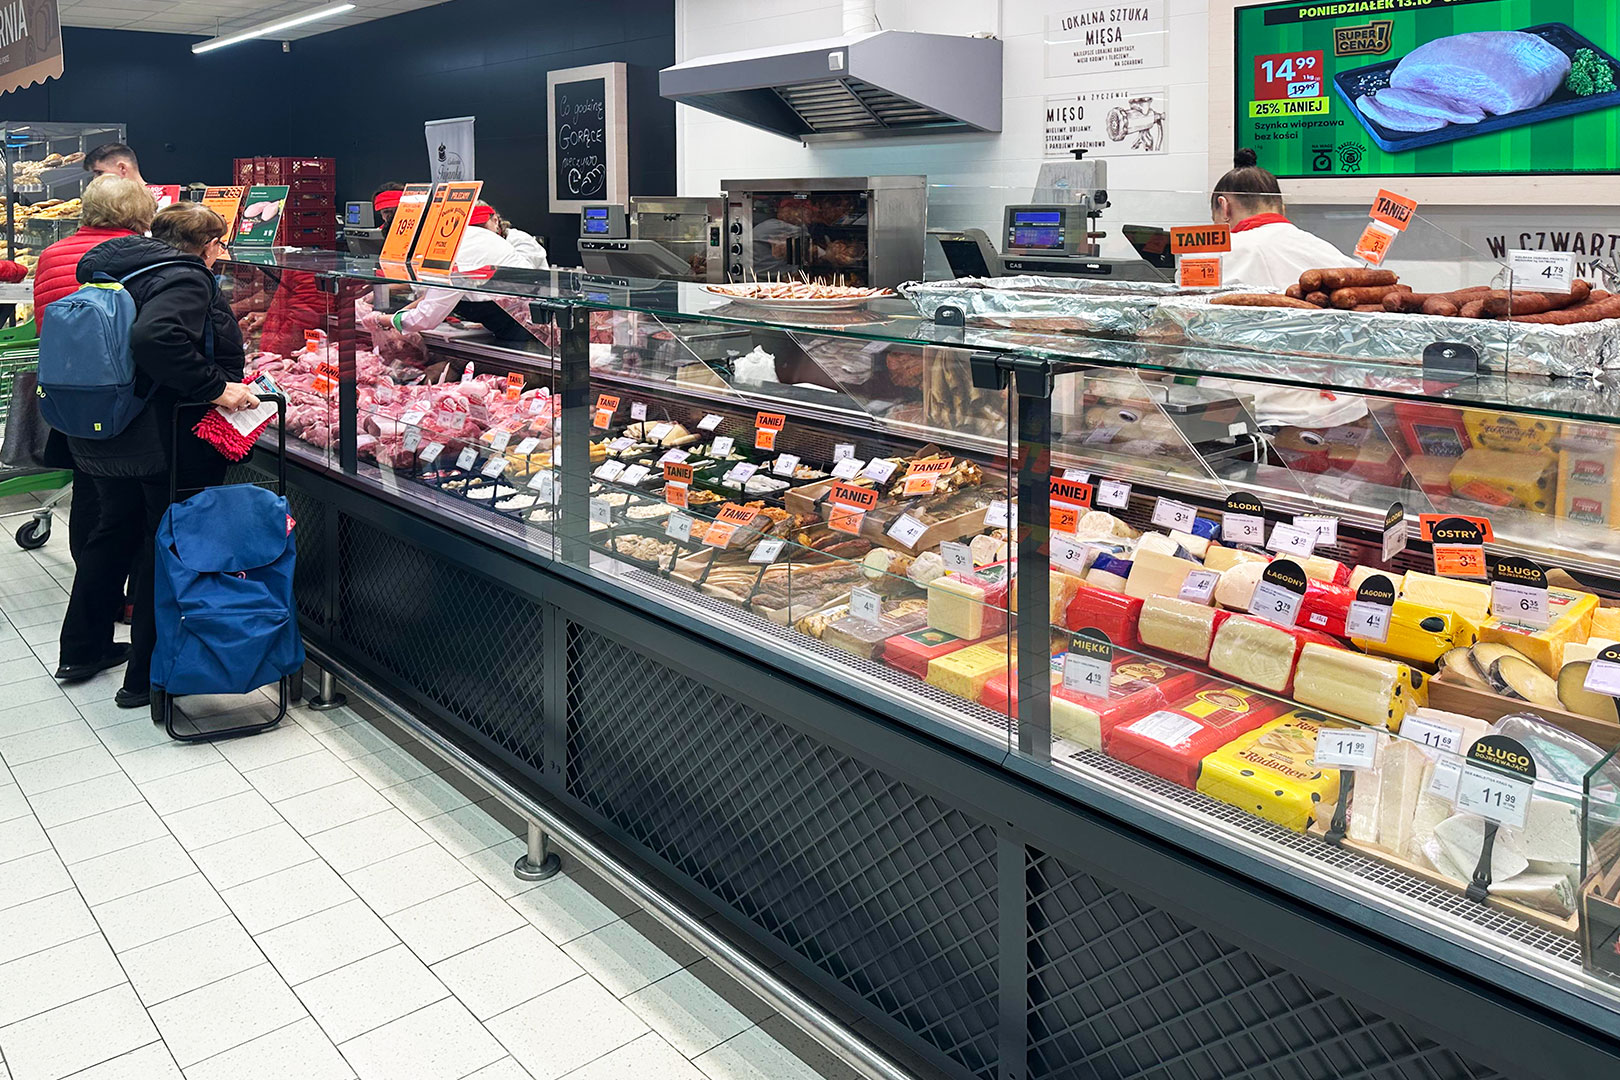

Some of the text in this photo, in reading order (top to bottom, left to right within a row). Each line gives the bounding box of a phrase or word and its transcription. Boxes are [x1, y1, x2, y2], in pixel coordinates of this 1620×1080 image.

[1061, 8, 1149, 31] LOKALNA SZTUKA
[1085, 26, 1122, 46] MIĘSA
[1338, 29, 1376, 41] SUPER
[1261, 55, 1316, 82] 14 99
[1046, 106, 1084, 124] MIĘSO
[1255, 100, 1323, 115] 25% TANIEJ
[1254, 119, 1345, 132] Szynka wieprzowa
[559, 124, 602, 149] GORĄCE
[1254, 131, 1299, 141] bez kości
[1376, 197, 1414, 223] TANIEJ
[1176, 230, 1227, 247] TANIEJ
[1486, 235, 1506, 259] W
[1541, 265, 1552, 279] 4
[600, 397, 617, 409] TANIEJ
[759, 415, 783, 427] TANIEJ
[666, 465, 692, 480] TANIEJ
[912, 460, 950, 472] TANIEJ
[835, 487, 874, 506] TANIEJ
[1227, 501, 1261, 512] SŁODKI
[723, 507, 753, 522] TANIEJ
[1243, 525, 1251, 536] 3
[1436, 529, 1478, 539] OSTRY
[1066, 549, 1074, 560] 3
[1459, 555, 1469, 567] 3
[1498, 563, 1541, 578] DŁUGO
[1266, 569, 1304, 588] ŁAGODNY
[1359, 588, 1393, 599] ŁAGODNY
[1274, 600, 1283, 612] 3
[1519, 598, 1529, 611] 6
[1366, 614, 1374, 627] 4
[1072, 639, 1110, 655] MIĘKKI
[1085, 672, 1093, 684] 4
[1423, 731, 1441, 748] 11
[1337, 740, 1353, 755] 11
[1476, 743, 1530, 766] DŁUGO
[1241, 750, 1307, 780] Radamer
[1475, 752, 1529, 772] DOJRZEWAJĄCY
[1483, 788, 1516, 807] 11 99
